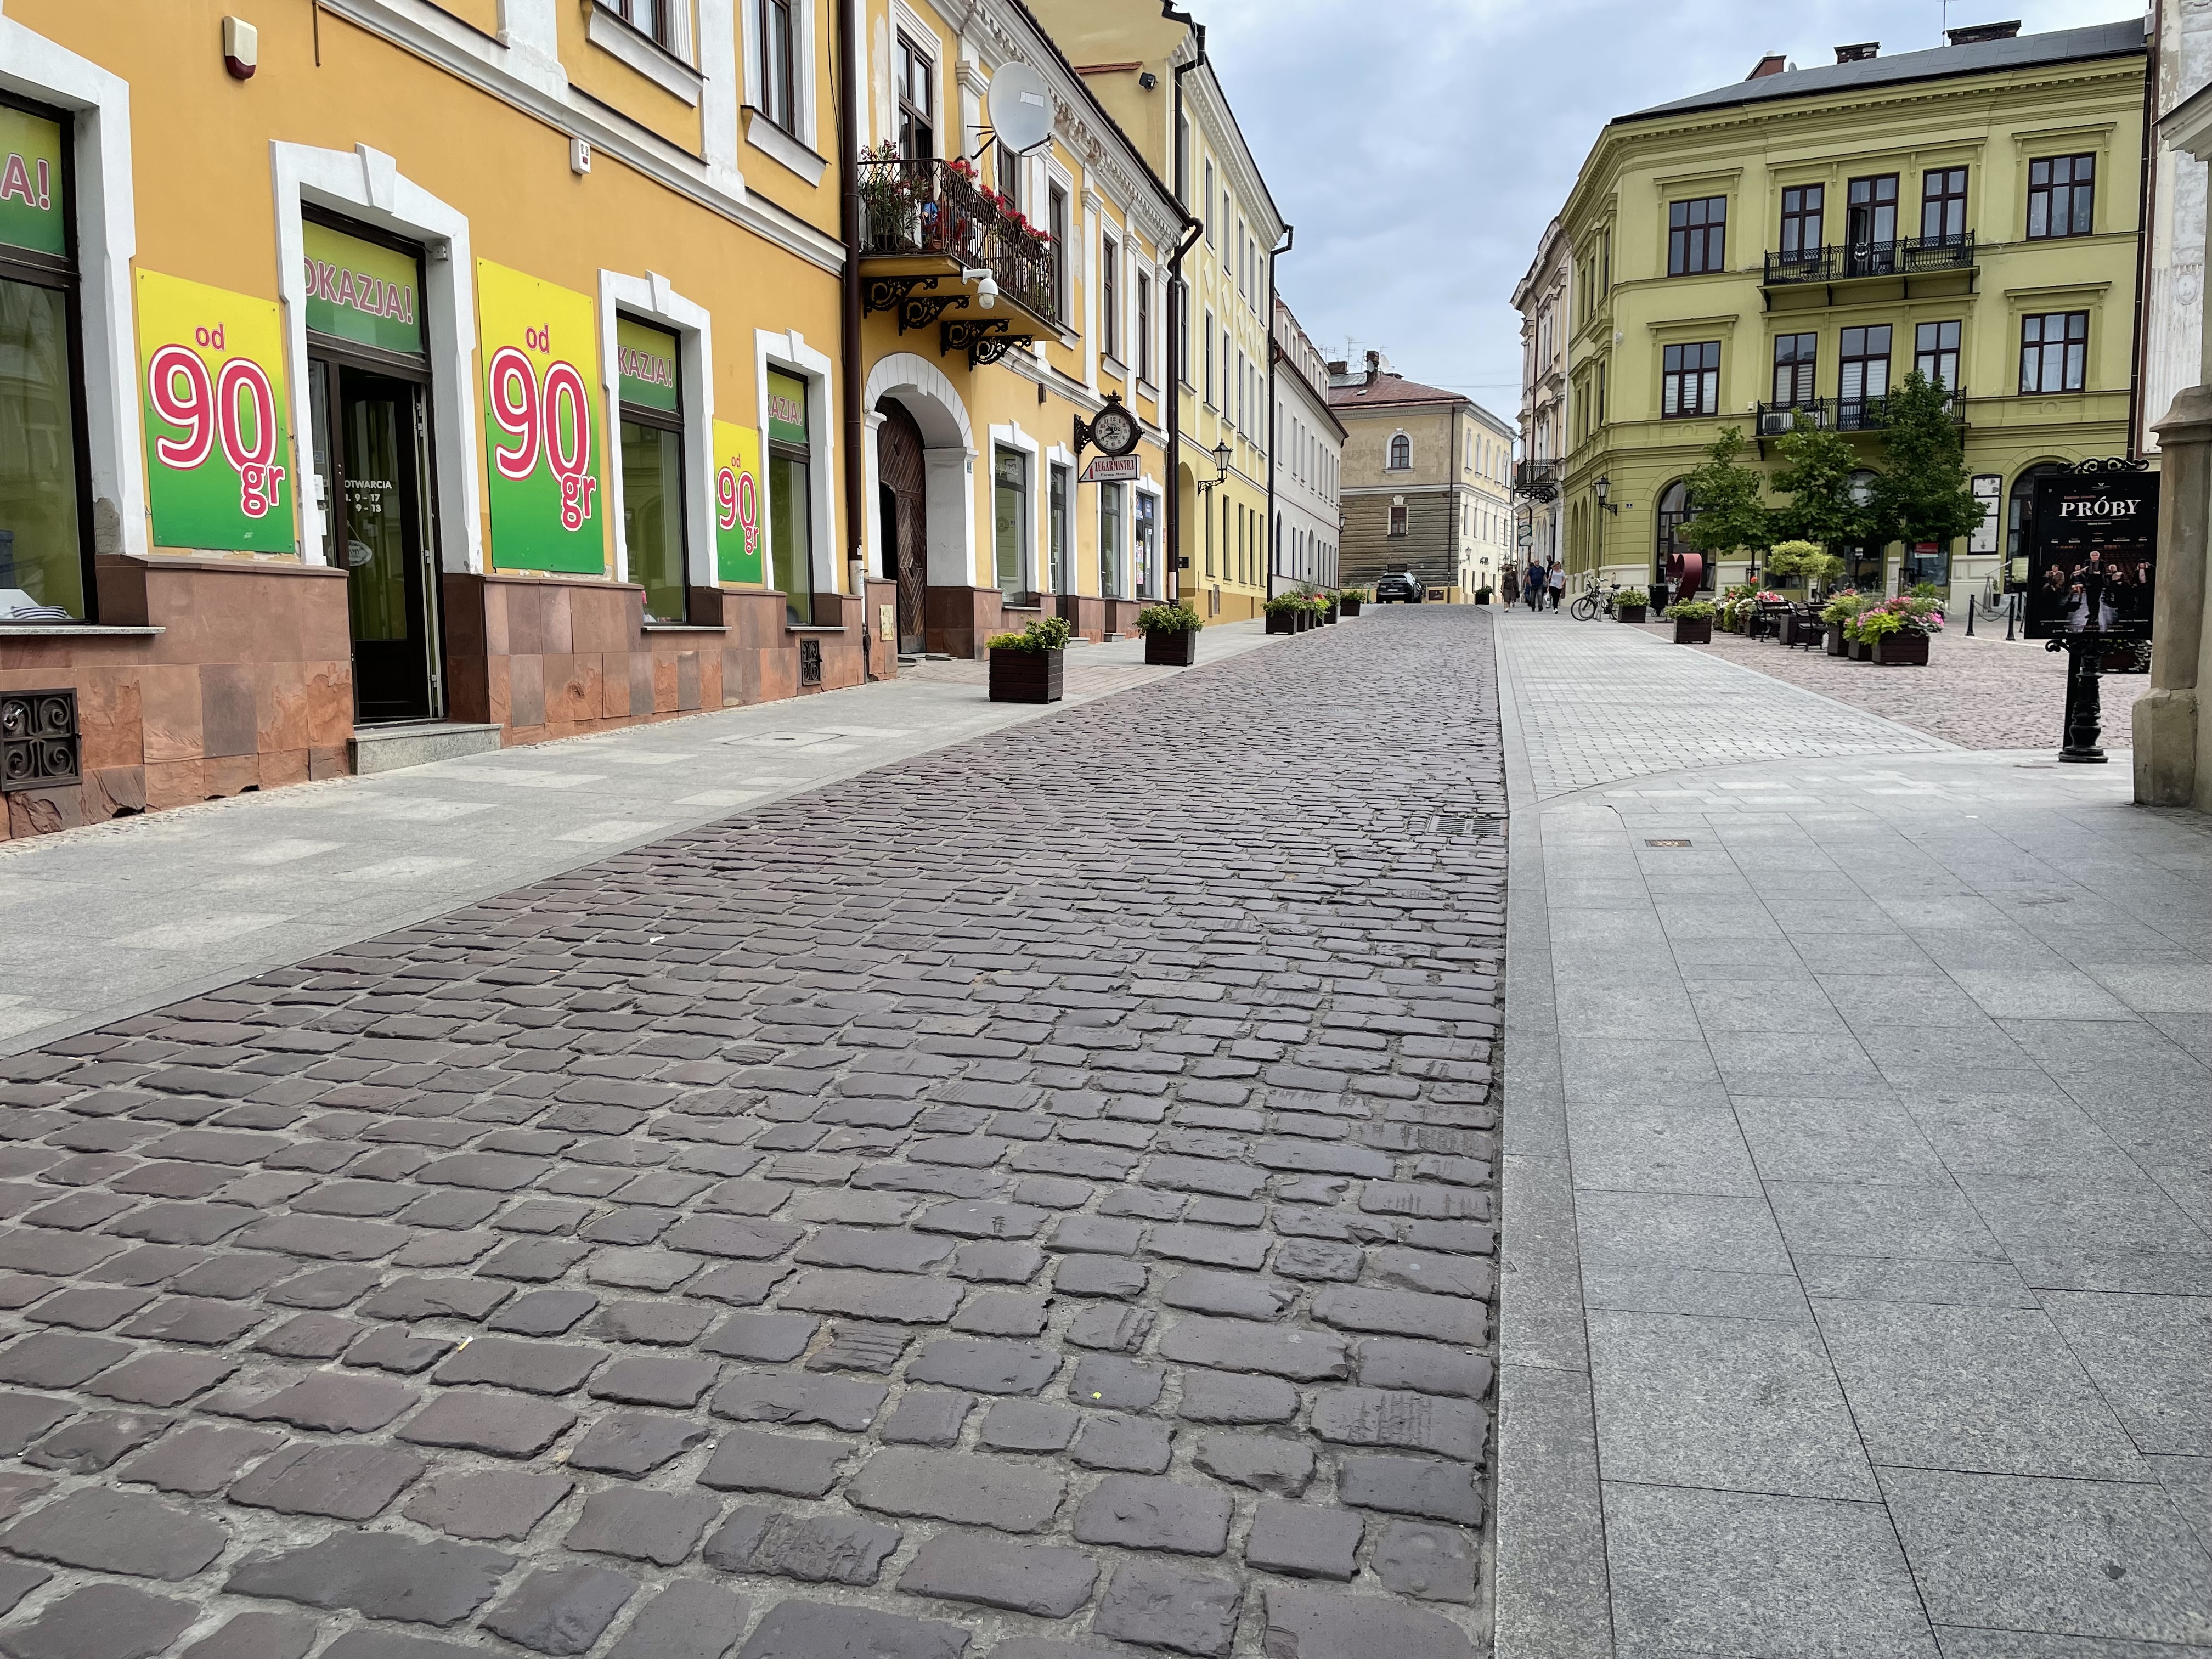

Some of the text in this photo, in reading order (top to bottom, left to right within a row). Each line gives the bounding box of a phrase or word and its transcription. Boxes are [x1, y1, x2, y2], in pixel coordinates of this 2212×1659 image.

[195, 321, 226, 352] od
[526, 323, 550, 354] od
[148, 343, 278, 474] 90
[489, 345, 591, 484] 90
[731, 453, 741, 468] od
[1094, 460, 1134, 472] ZEGARMISTRZ
[240, 462, 285, 518] gr
[345, 480, 392, 489] OTWARCIA
[717, 466, 757, 531] 90
[371, 504, 381, 512] 13
[561, 472, 596, 532] gr
[2059, 496, 2141, 517] PRÓBY
[744, 526, 759, 555] gr
